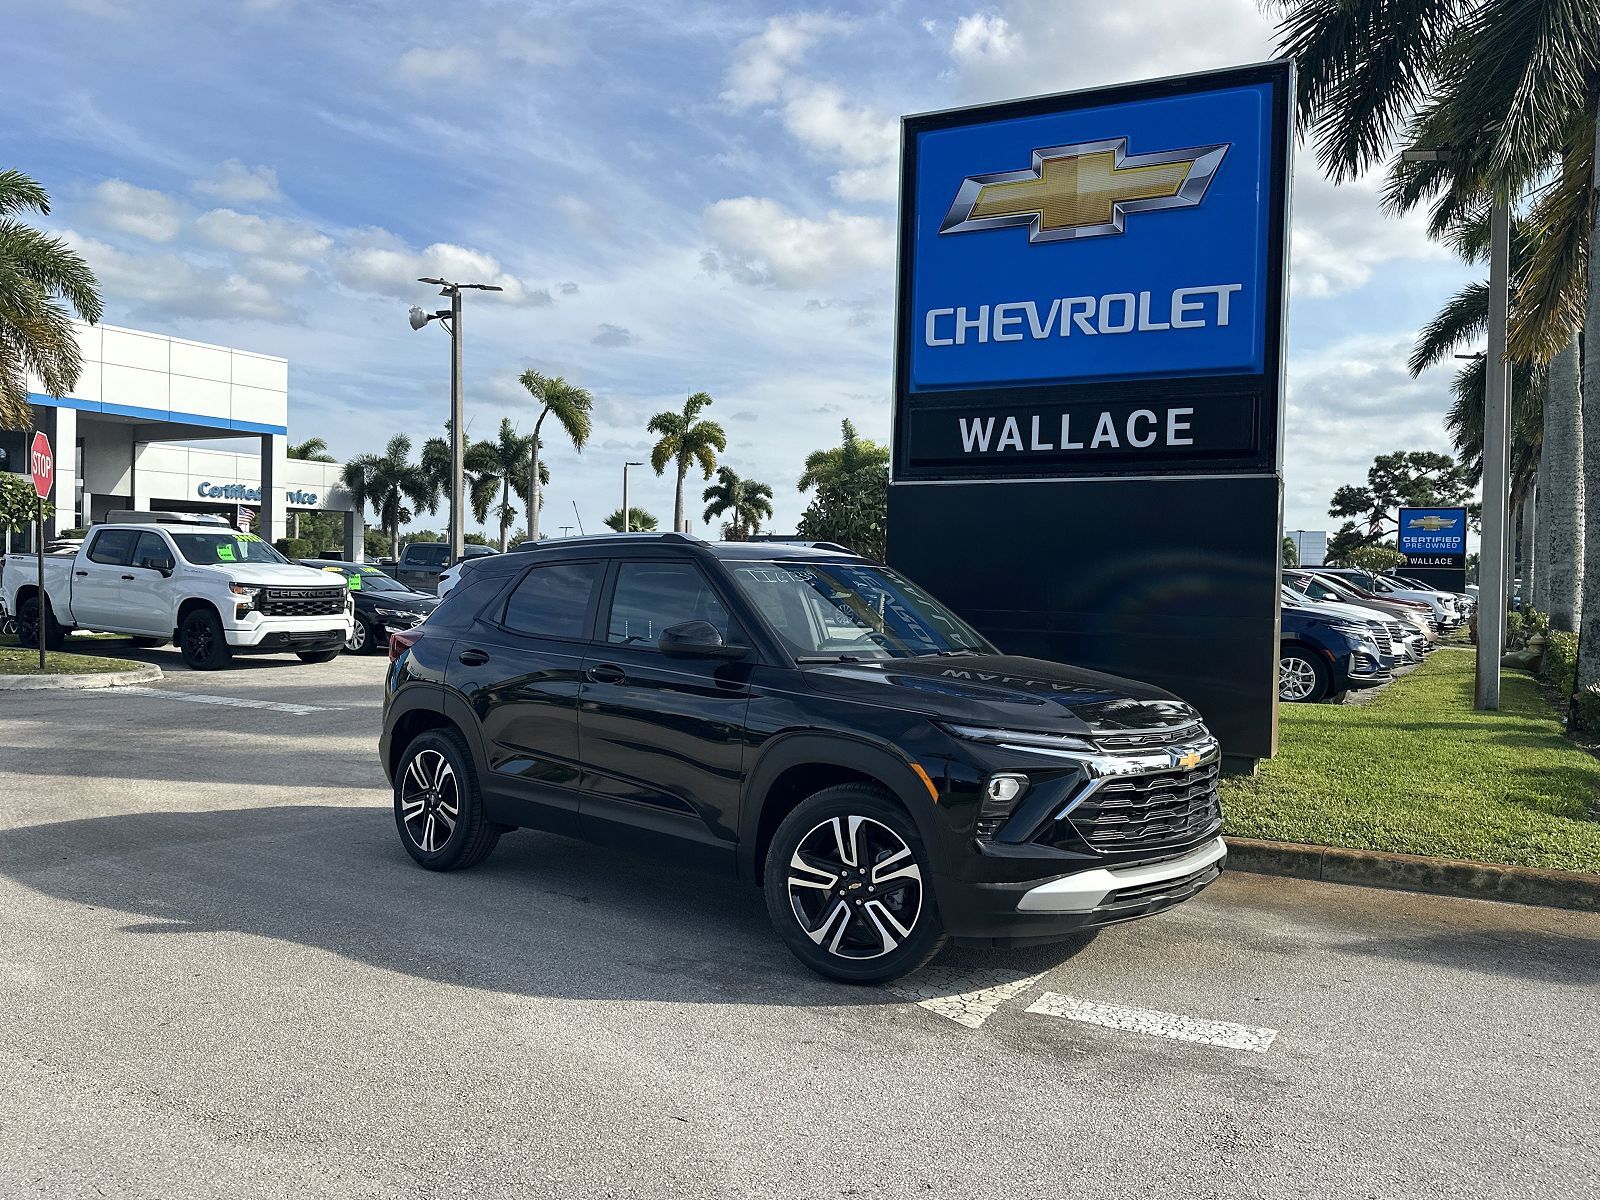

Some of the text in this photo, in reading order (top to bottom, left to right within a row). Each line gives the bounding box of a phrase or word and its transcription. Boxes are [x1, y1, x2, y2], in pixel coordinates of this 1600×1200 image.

[925, 283, 1242, 347] CHEVROLET
[958, 407, 1194, 453] WALLACE
[32, 450, 51, 479] STOP
[197, 481, 318, 505] Certified rvice
[1409, 557, 1453, 566] WALLACE
